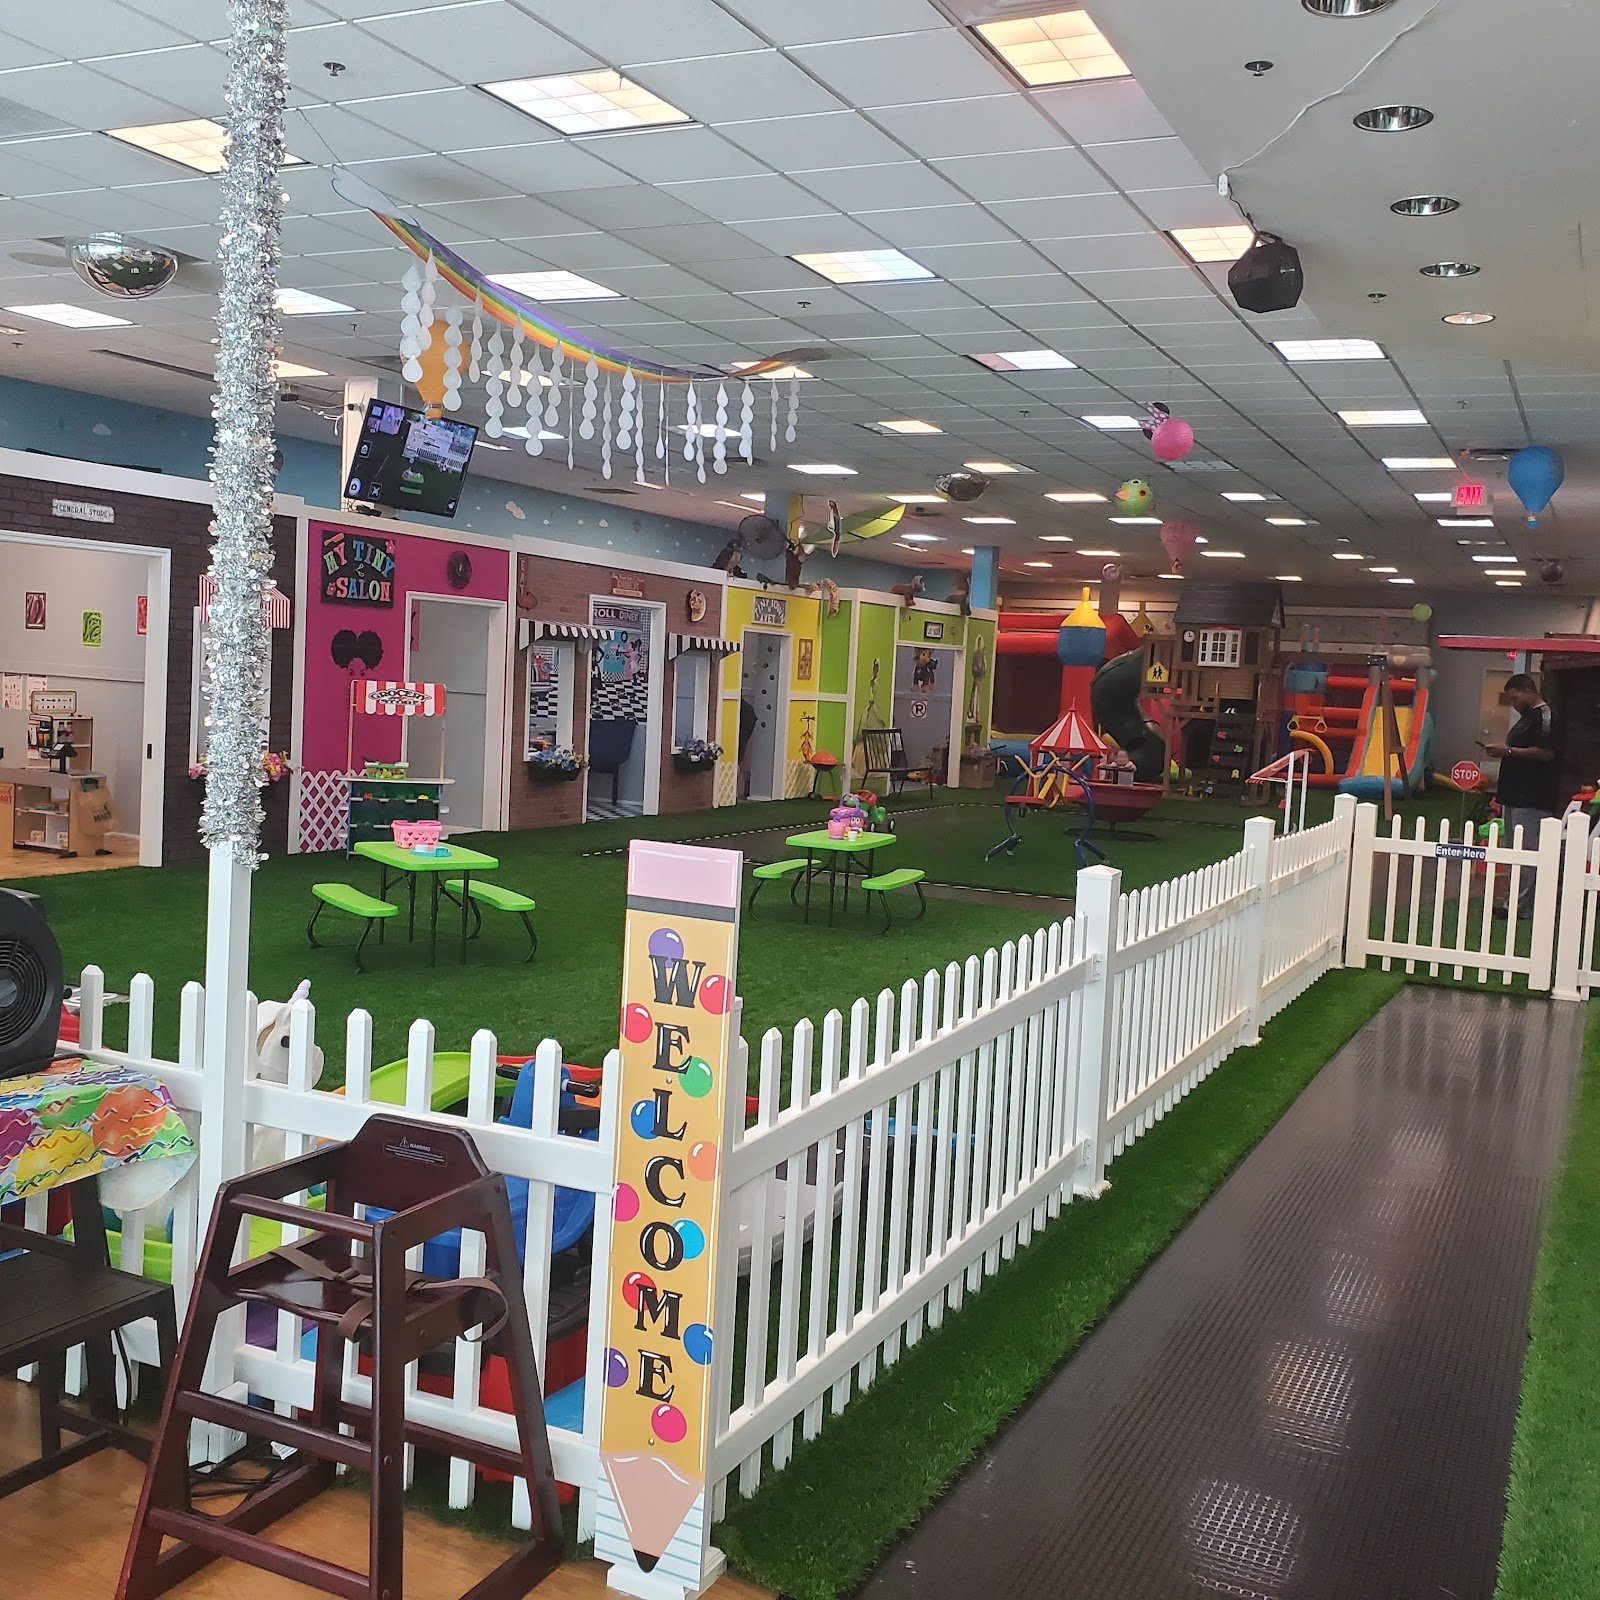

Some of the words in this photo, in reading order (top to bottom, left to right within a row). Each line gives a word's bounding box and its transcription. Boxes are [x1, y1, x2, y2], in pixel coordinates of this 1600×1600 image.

[1455, 484, 1485, 505] EXIT
[59, 503, 87, 515] GENERAL
[88, 508, 111, 518] STORE
[323, 541, 348, 576] MY
[352, 539, 396, 578] TINY
[336, 577, 391, 602] SALON
[593, 608, 616, 619] ROLL
[619, 610, 640, 621] DINER
[368, 687, 433, 702] GROCERY
[1453, 768, 1479, 780] STOP
[1436, 845, 1461, 857] Enter
[1463, 847, 1486, 859] Here
[635, 954, 707, 1404] WELCOME
